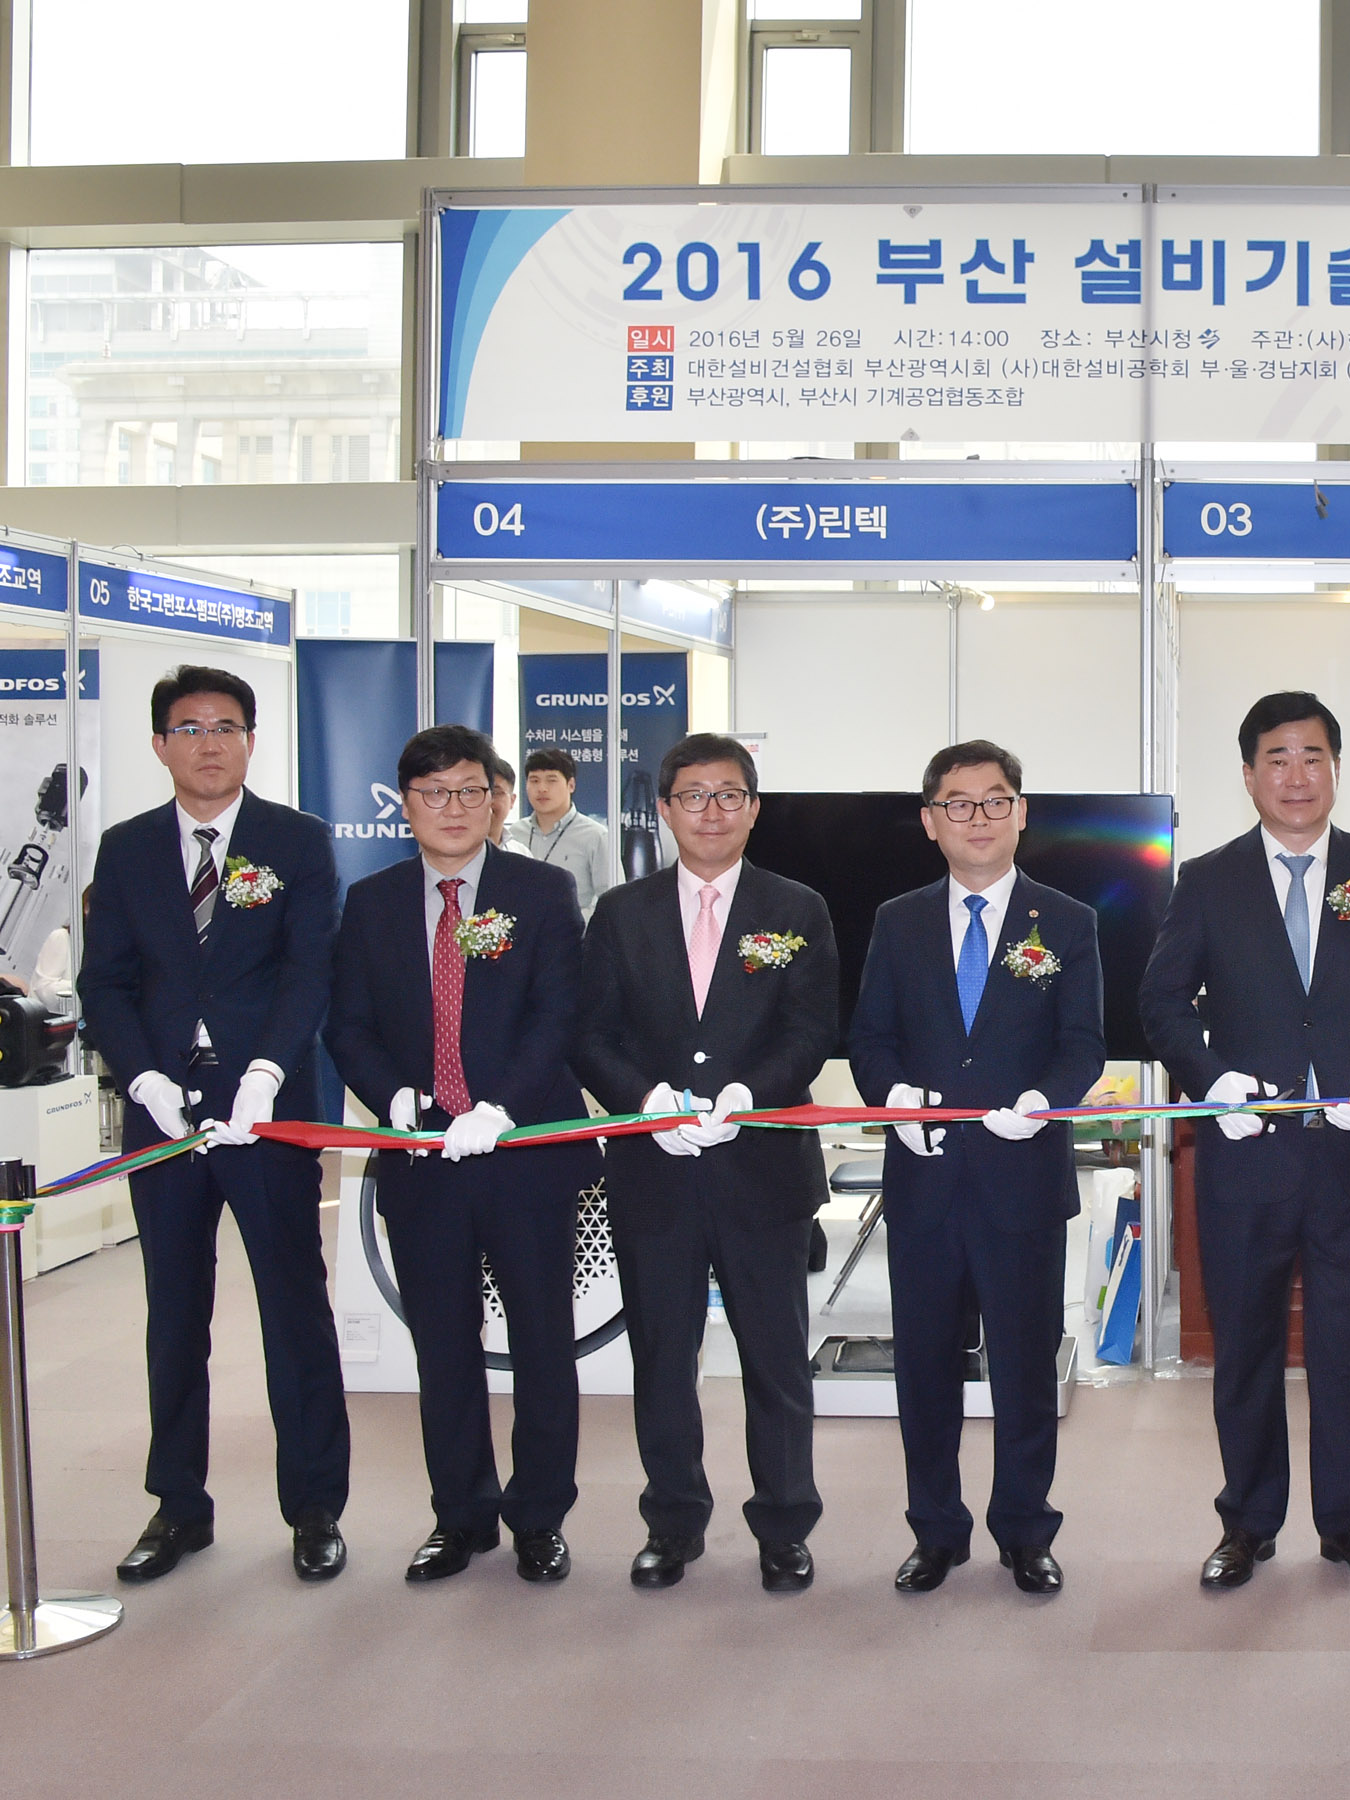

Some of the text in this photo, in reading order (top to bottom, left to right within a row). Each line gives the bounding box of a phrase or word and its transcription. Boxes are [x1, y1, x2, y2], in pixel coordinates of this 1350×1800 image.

[622, 241, 832, 302] 2016
[876, 239, 1035, 305] 부산
[631, 329, 672, 350] 일시
[690, 329, 760, 349] 2016년
[772, 329, 805, 349] 5월
[816, 329, 861, 349] 26일
[1040, 329, 1092, 349] 장소:
[1104, 329, 1191, 349] 부산시청
[629, 358, 670, 380] 주최
[688, 359, 853, 379] 대한설비건설협회
[864, 359, 990, 379] 부산광역시회
[1002, 358, 1189, 379] (사)대한설비공학회
[629, 387, 1024, 408] 후원 부산광역시, 부산시 기계공업협동조합
[472, 503, 525, 536] 04
[755, 503, 888, 540] (주)린텍
[1200, 502, 1253, 536] 03
[89, 578, 110, 606] 05
[535, 693, 651, 707] GRUNDOS
[24, 713, 57, 727] 솔루션
[525, 729, 556, 742] 수처리
[560, 728, 603, 742] 시스템을
[607, 748, 639, 762] 루션
[330, 823, 415, 839] RUND
[46, 1100, 83, 1115] GRUNDFOS
